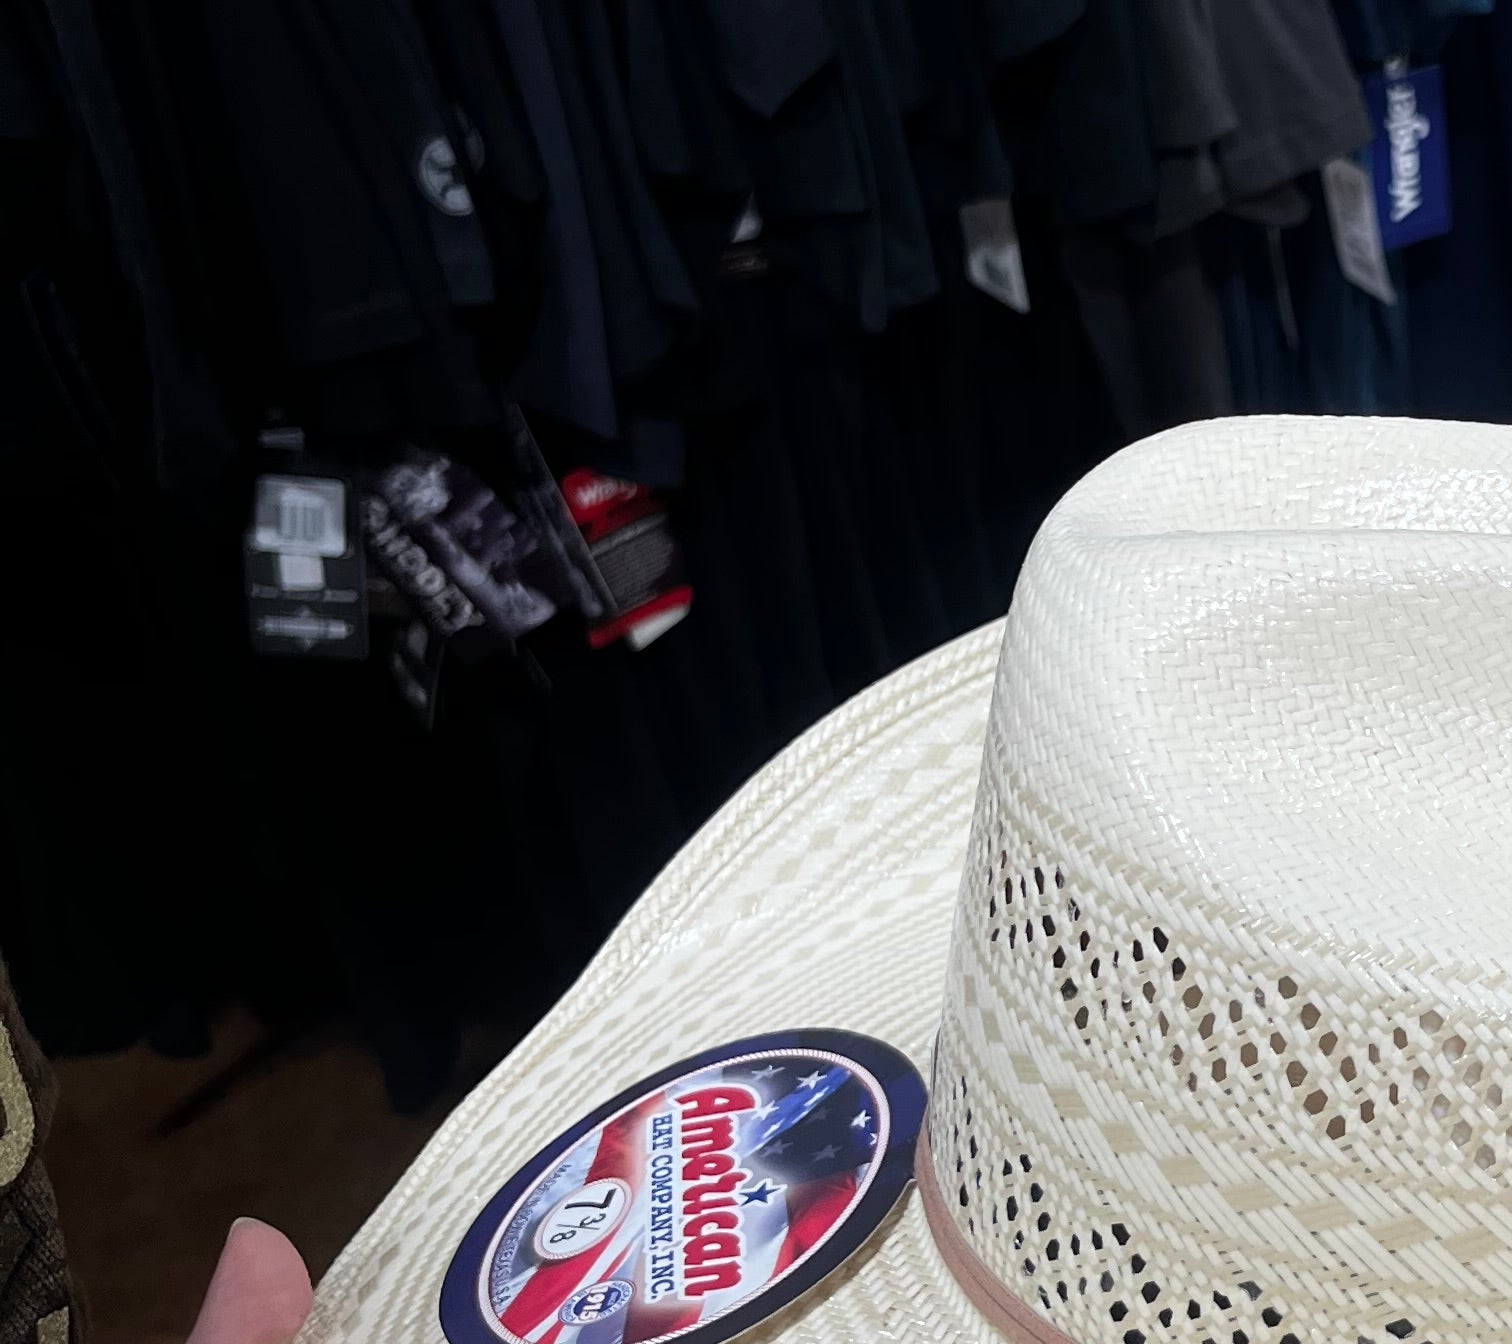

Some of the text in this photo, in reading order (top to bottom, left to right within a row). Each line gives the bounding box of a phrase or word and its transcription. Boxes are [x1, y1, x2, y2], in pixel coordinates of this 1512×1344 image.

[1386, 83, 1430, 222] Wrangler
[649, 1114, 674, 1301] HAT COMPANY, INC.
[675, 1086, 756, 1297] American
[575, 1286, 608, 1320] 1915
